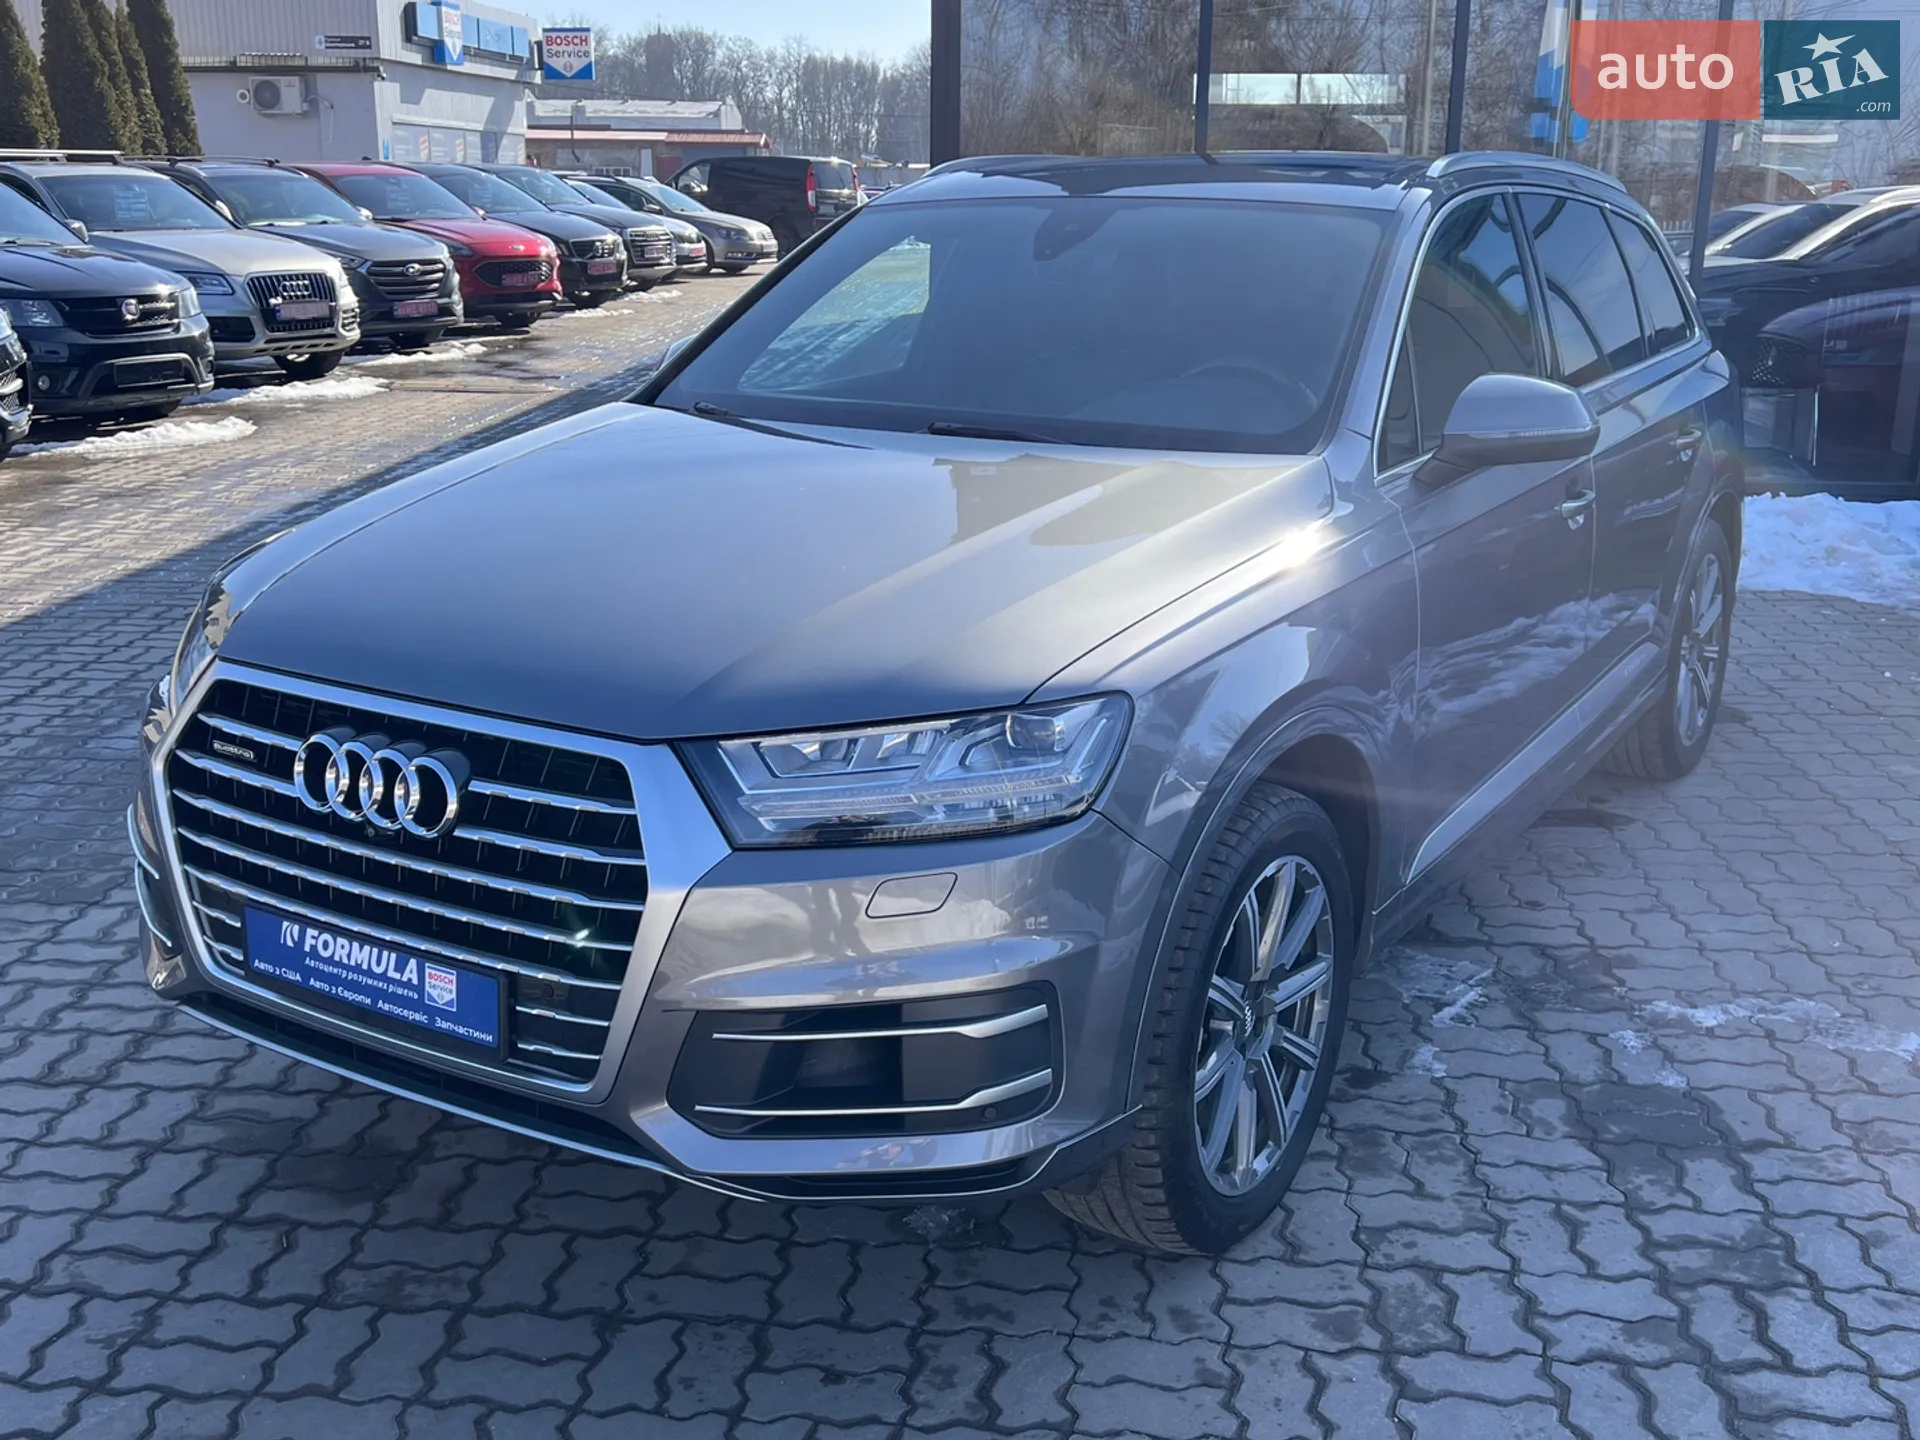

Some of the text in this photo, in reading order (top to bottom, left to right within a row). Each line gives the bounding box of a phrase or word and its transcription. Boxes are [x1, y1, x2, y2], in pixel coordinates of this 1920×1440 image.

[545, 35, 588, 46] BOSCH
[546, 47, 590, 58] Service
[304, 928, 419, 985] FORMULA
[254, 959, 302, 982] Авто з США
[304, 956, 419, 999] Автоцентр розумних рішень
[428, 971, 454, 986] BOSCH
[309, 977, 371, 1005] Авто з Європи
[377, 1000, 428, 1023] Автосервіс
[435, 1017, 493, 1042] Запчастини
